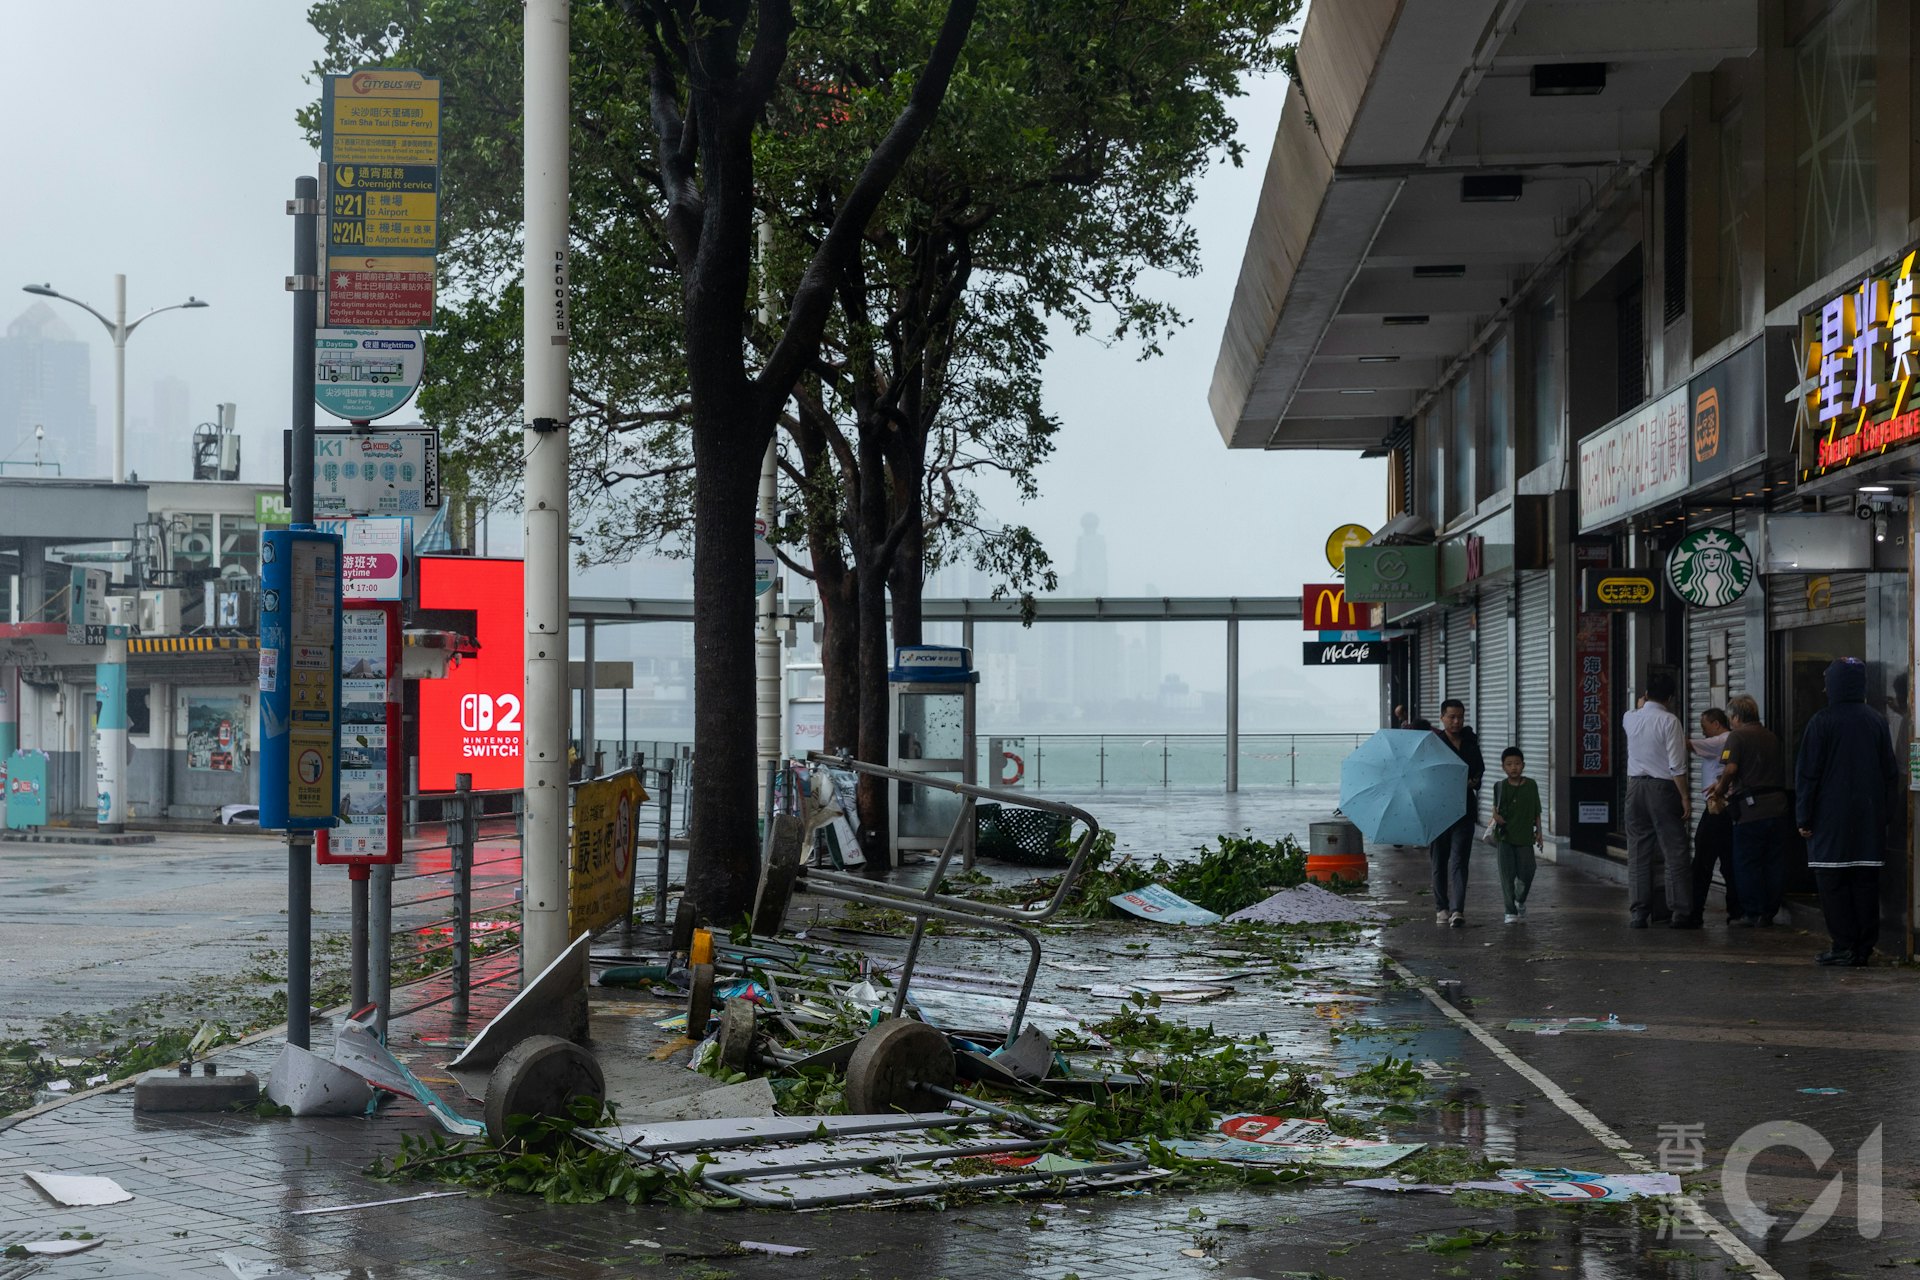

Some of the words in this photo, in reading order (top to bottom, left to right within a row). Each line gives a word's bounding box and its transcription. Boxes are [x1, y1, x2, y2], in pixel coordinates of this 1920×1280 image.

[362, 80, 404, 89] CITYBUS
[340, 118, 357, 126] Tsim
[359, 119, 374, 127] Sha
[375, 119, 391, 127] Tsui
[391, 119, 410, 128] (Star
[411, 120, 433, 129] Ferry)
[358, 166, 405, 179] 通宵服務
[357, 180, 402, 190] Overnight
[336, 194, 363, 216] N21
[367, 208, 376, 216] to
[377, 208, 409, 218] Airport
[375, 236, 402, 245] Airport
[341, 301, 365, 309] daytime
[395, 311, 421, 319] Salisbury
[325, 341, 354, 350] Daytime
[380, 341, 415, 351] Nighttime
[342, 569, 371, 579] aytime
[356, 584, 378, 592] 17:00
[88, 626, 104, 635] YT
[88, 636, 104, 645] 910
[1321, 642, 1370, 664] McCafé
[496, 693, 522, 732] 2
[1583, 656, 1602, 770] 海外升學權威
[463, 736, 520, 744] NINTENDO
[462, 745, 520, 757] SWITCH
